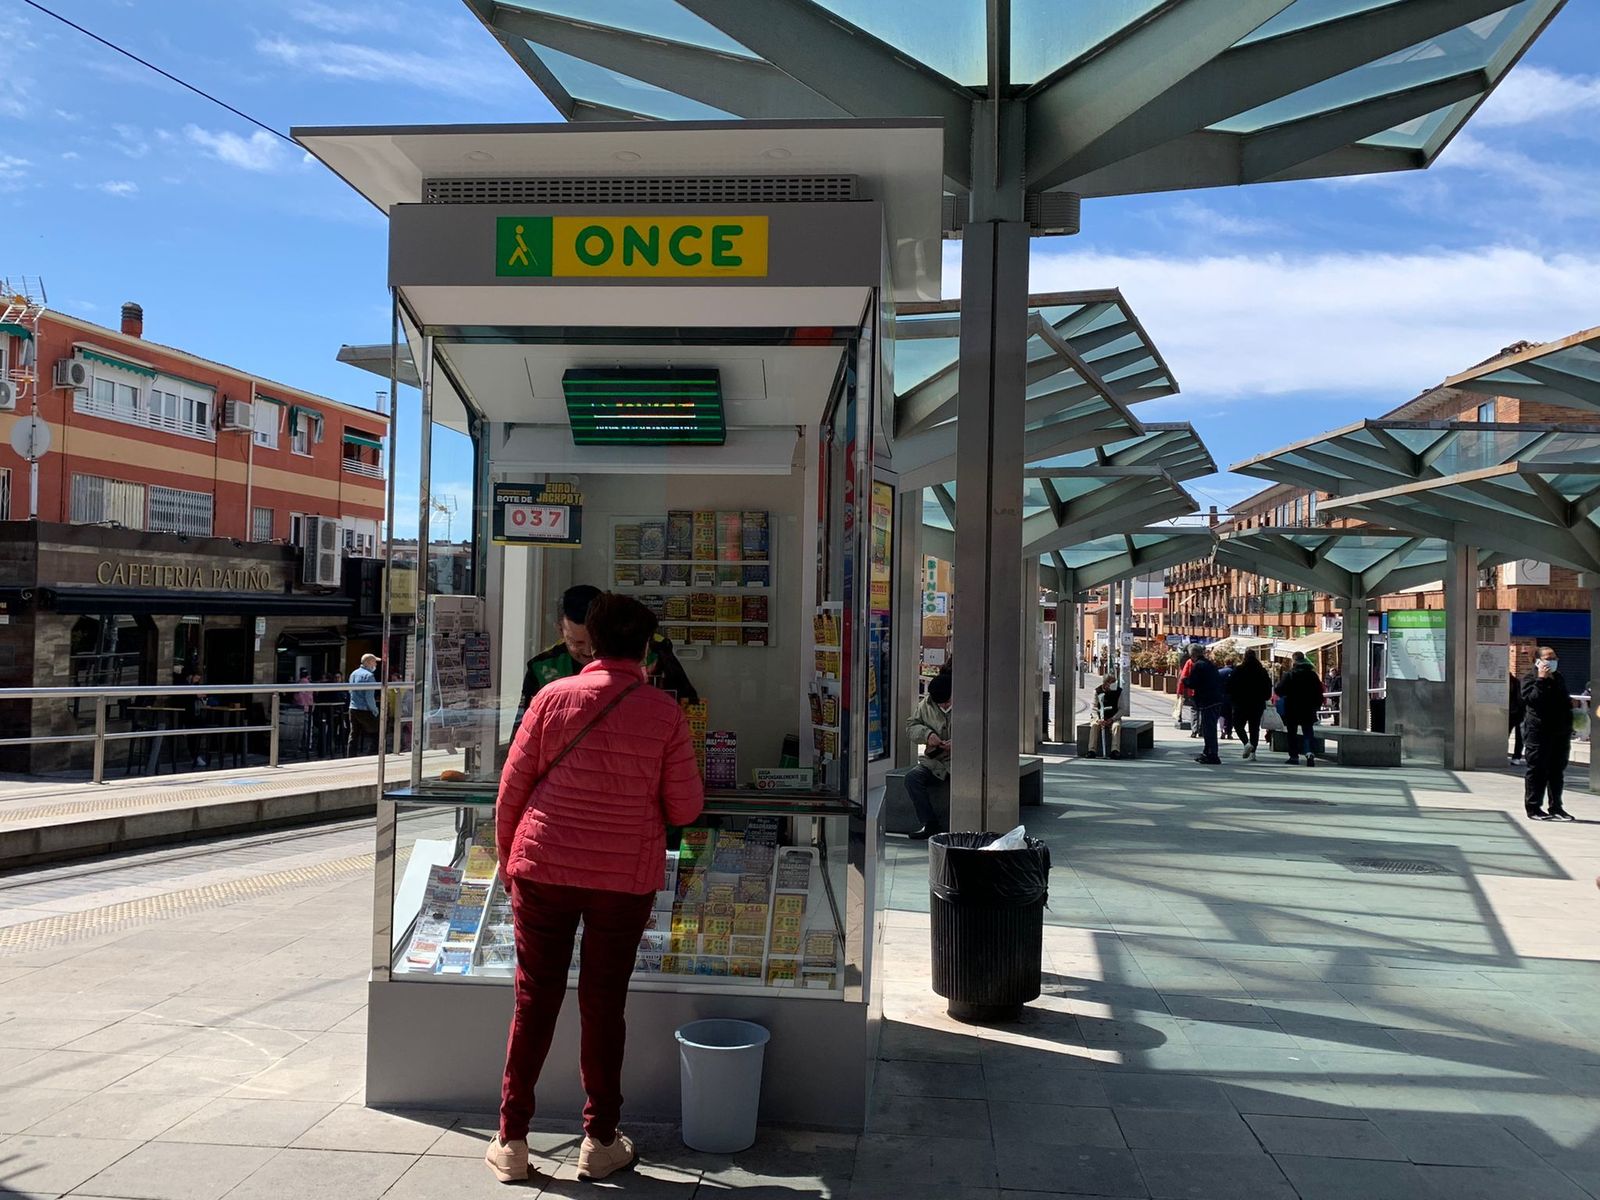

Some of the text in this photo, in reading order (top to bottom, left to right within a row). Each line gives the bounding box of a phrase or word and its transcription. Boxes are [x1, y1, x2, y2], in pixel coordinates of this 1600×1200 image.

[575, 225, 743, 266] ONCE
[545, 484, 571, 493] EURO
[497, 495, 519, 503] BOTE
[536, 493, 580, 503] JACKPOT
[512, 509, 561, 527] 037
[96, 561, 271, 590] CAFETERIA PATIÑO
[926, 560, 937, 613] BINGO
